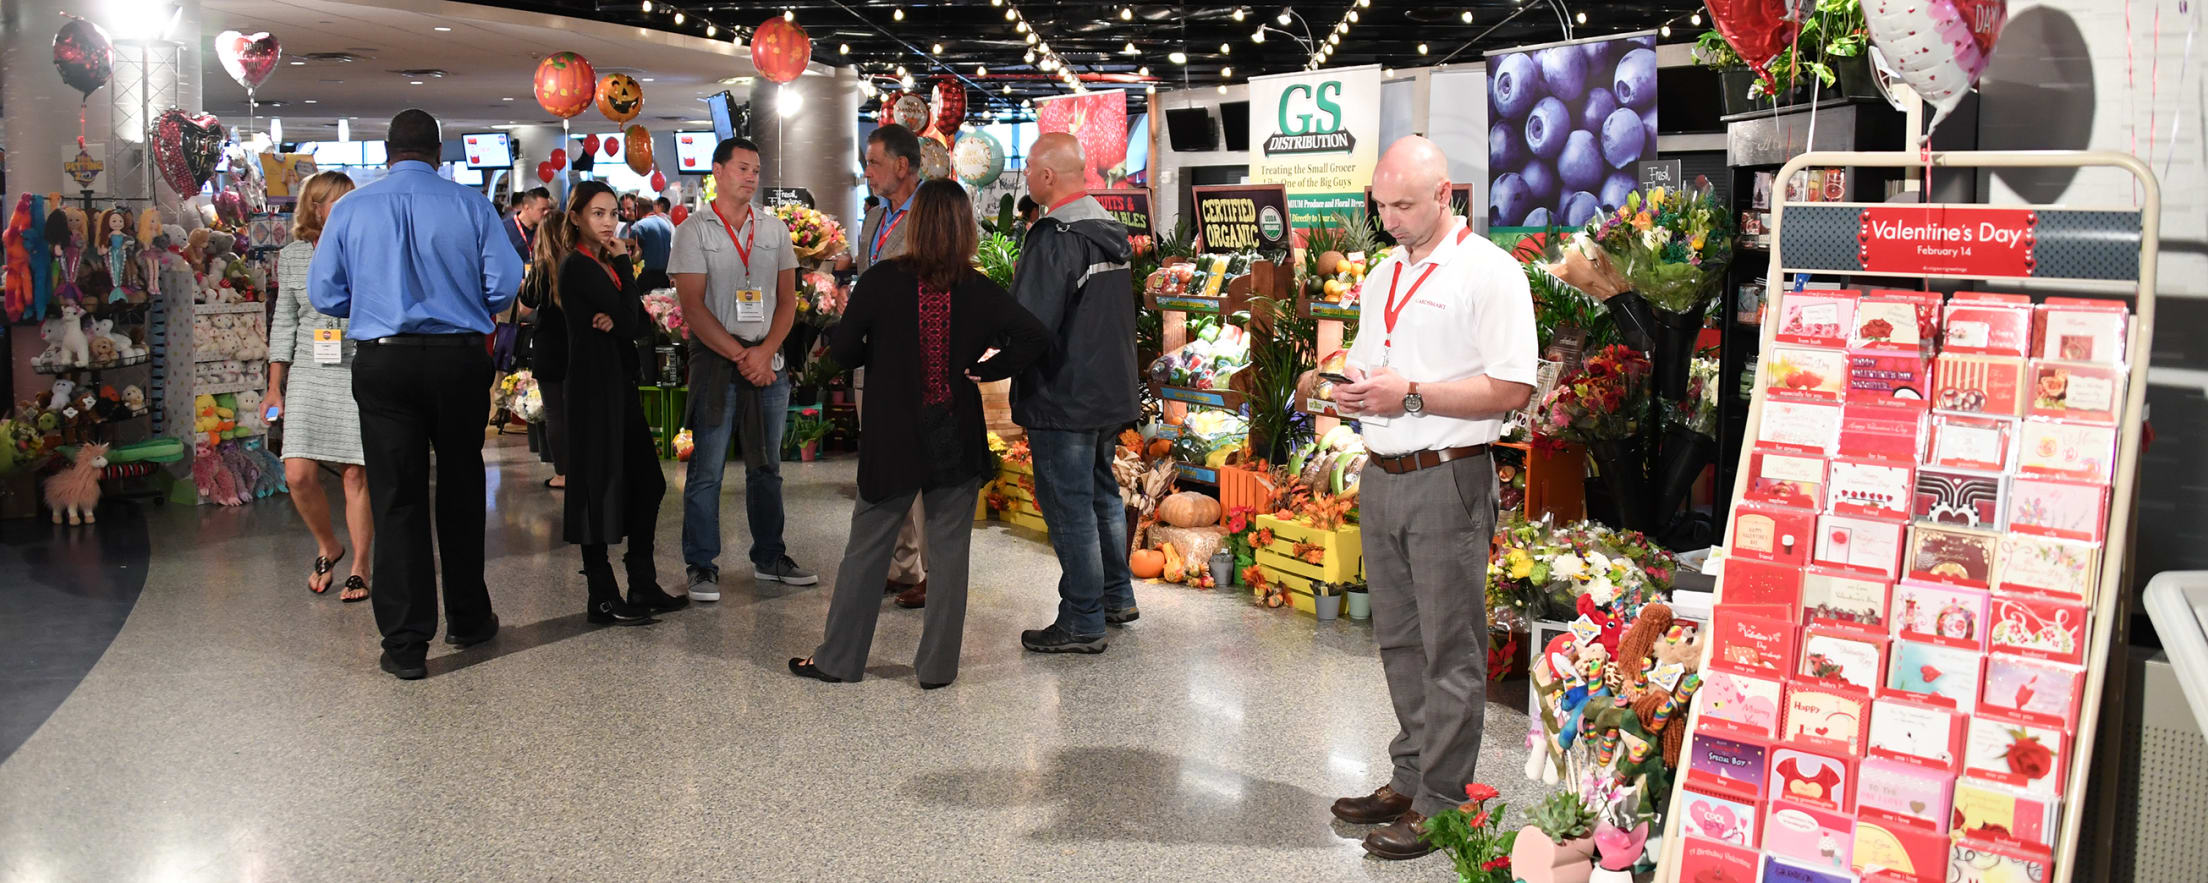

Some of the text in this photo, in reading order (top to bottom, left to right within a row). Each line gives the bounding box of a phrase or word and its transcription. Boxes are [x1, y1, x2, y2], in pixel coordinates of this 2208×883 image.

[1278, 81, 1342, 136] GS
[1269, 133, 1349, 151] DISTRIBUTION
[1261, 163, 1357, 177] Treating the Small Grocer
[1283, 179, 1297, 188] One
[1297, 178, 1305, 188] of
[1307, 178, 1318, 187] the
[1320, 178, 1332, 189] Big
[1333, 177, 1352, 189] Guys
[1127, 196, 1135, 212] &
[1202, 198, 1256, 222] CERTIFIED
[1304, 199, 1324, 208] Produce
[1325, 199, 1333, 208] and
[1206, 224, 1260, 248] ORGANIC
[1872, 219, 2023, 249] Valentine's Day
[1917, 245, 1972, 258] February 14
[1794, 702, 1820, 713] Happy
[1704, 811, 1726, 824] COOL
[1697, 848, 1723, 860] Birthday
